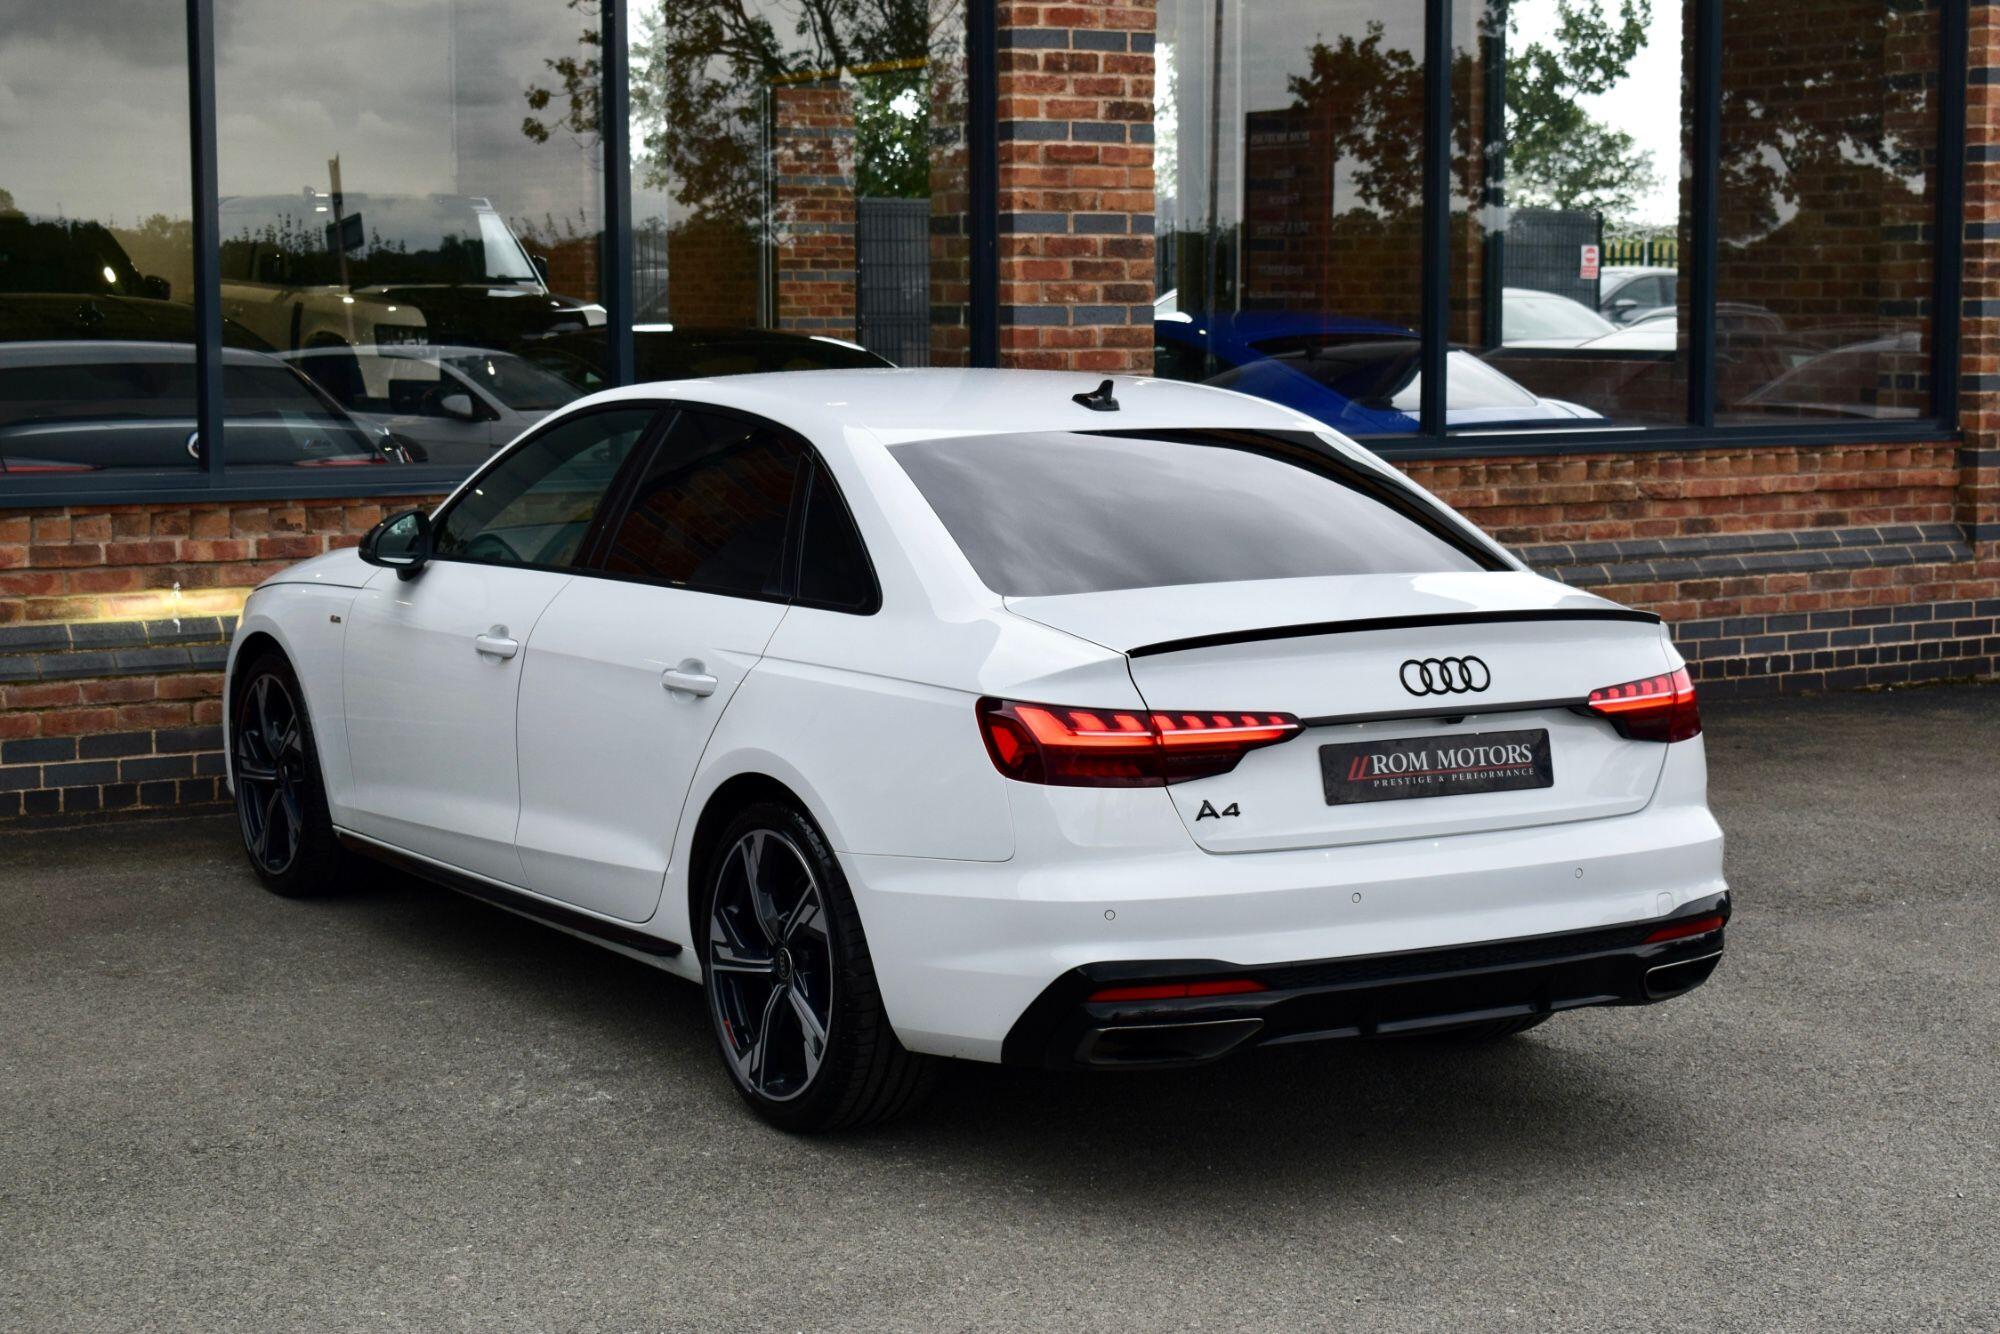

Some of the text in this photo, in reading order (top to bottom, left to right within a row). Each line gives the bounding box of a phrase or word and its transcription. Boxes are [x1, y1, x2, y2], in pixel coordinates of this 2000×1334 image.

[1371, 743, 1533, 775] ROM MOTORS
[1374, 776, 1432, 788] PRESTIGE
[1452, 768, 1535, 781] PERFORMANCE
[1195, 799, 1241, 822] A4
